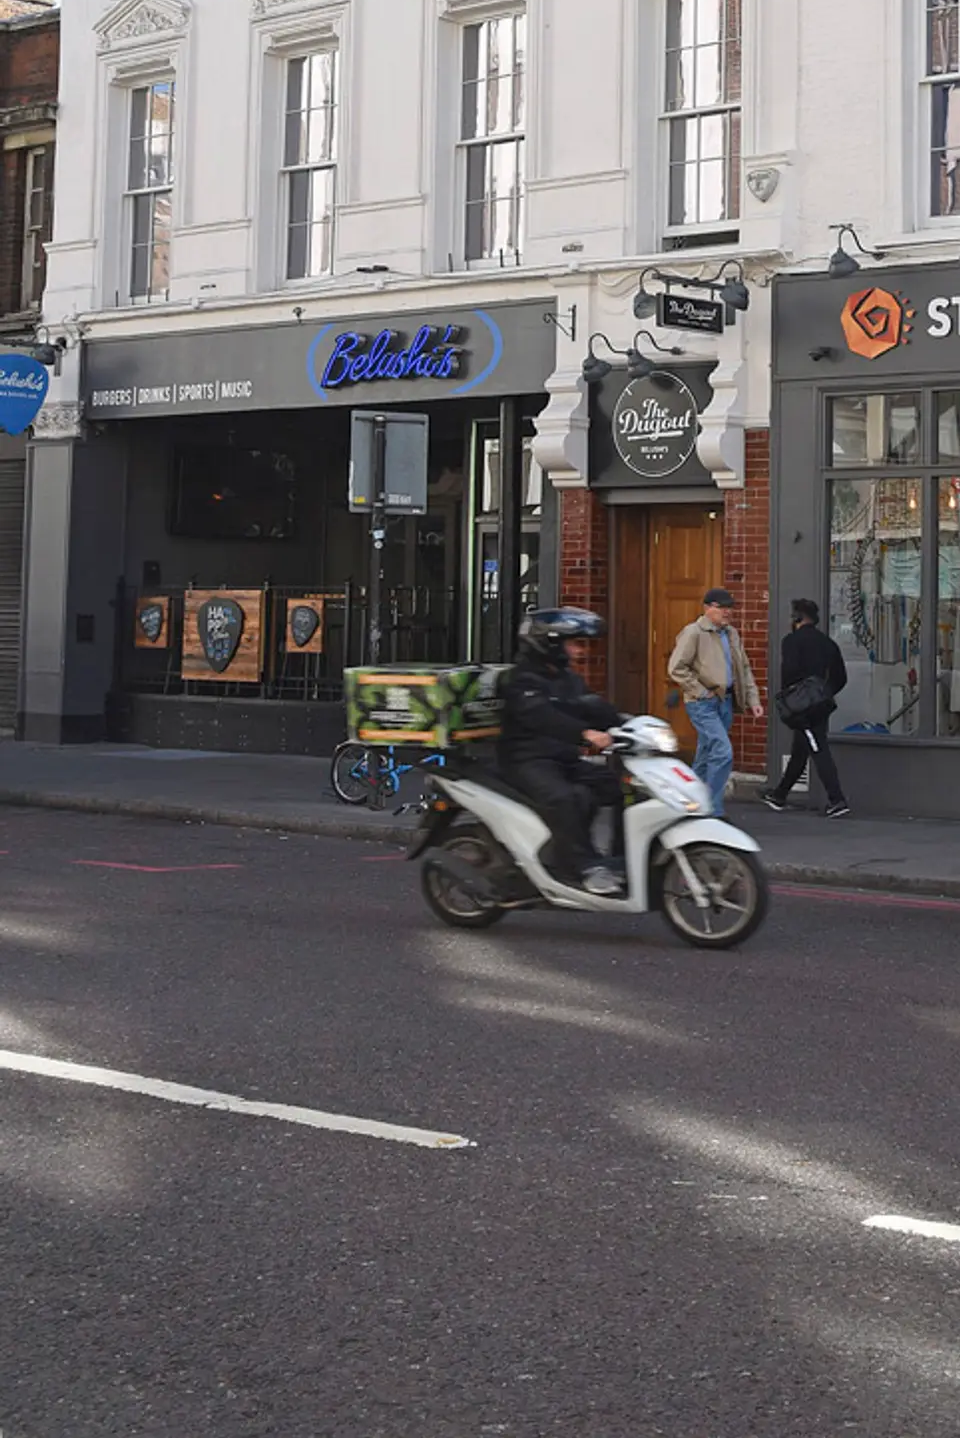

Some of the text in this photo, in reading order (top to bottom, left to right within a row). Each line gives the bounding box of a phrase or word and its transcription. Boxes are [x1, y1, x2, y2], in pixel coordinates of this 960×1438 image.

[320, 323, 460, 389] Belushi's
[92, 380, 252, 407] BURGERS DRINKS SPORTS MUSIC
[643, 398, 670, 419] The
[619, 407, 692, 441] Dugout
